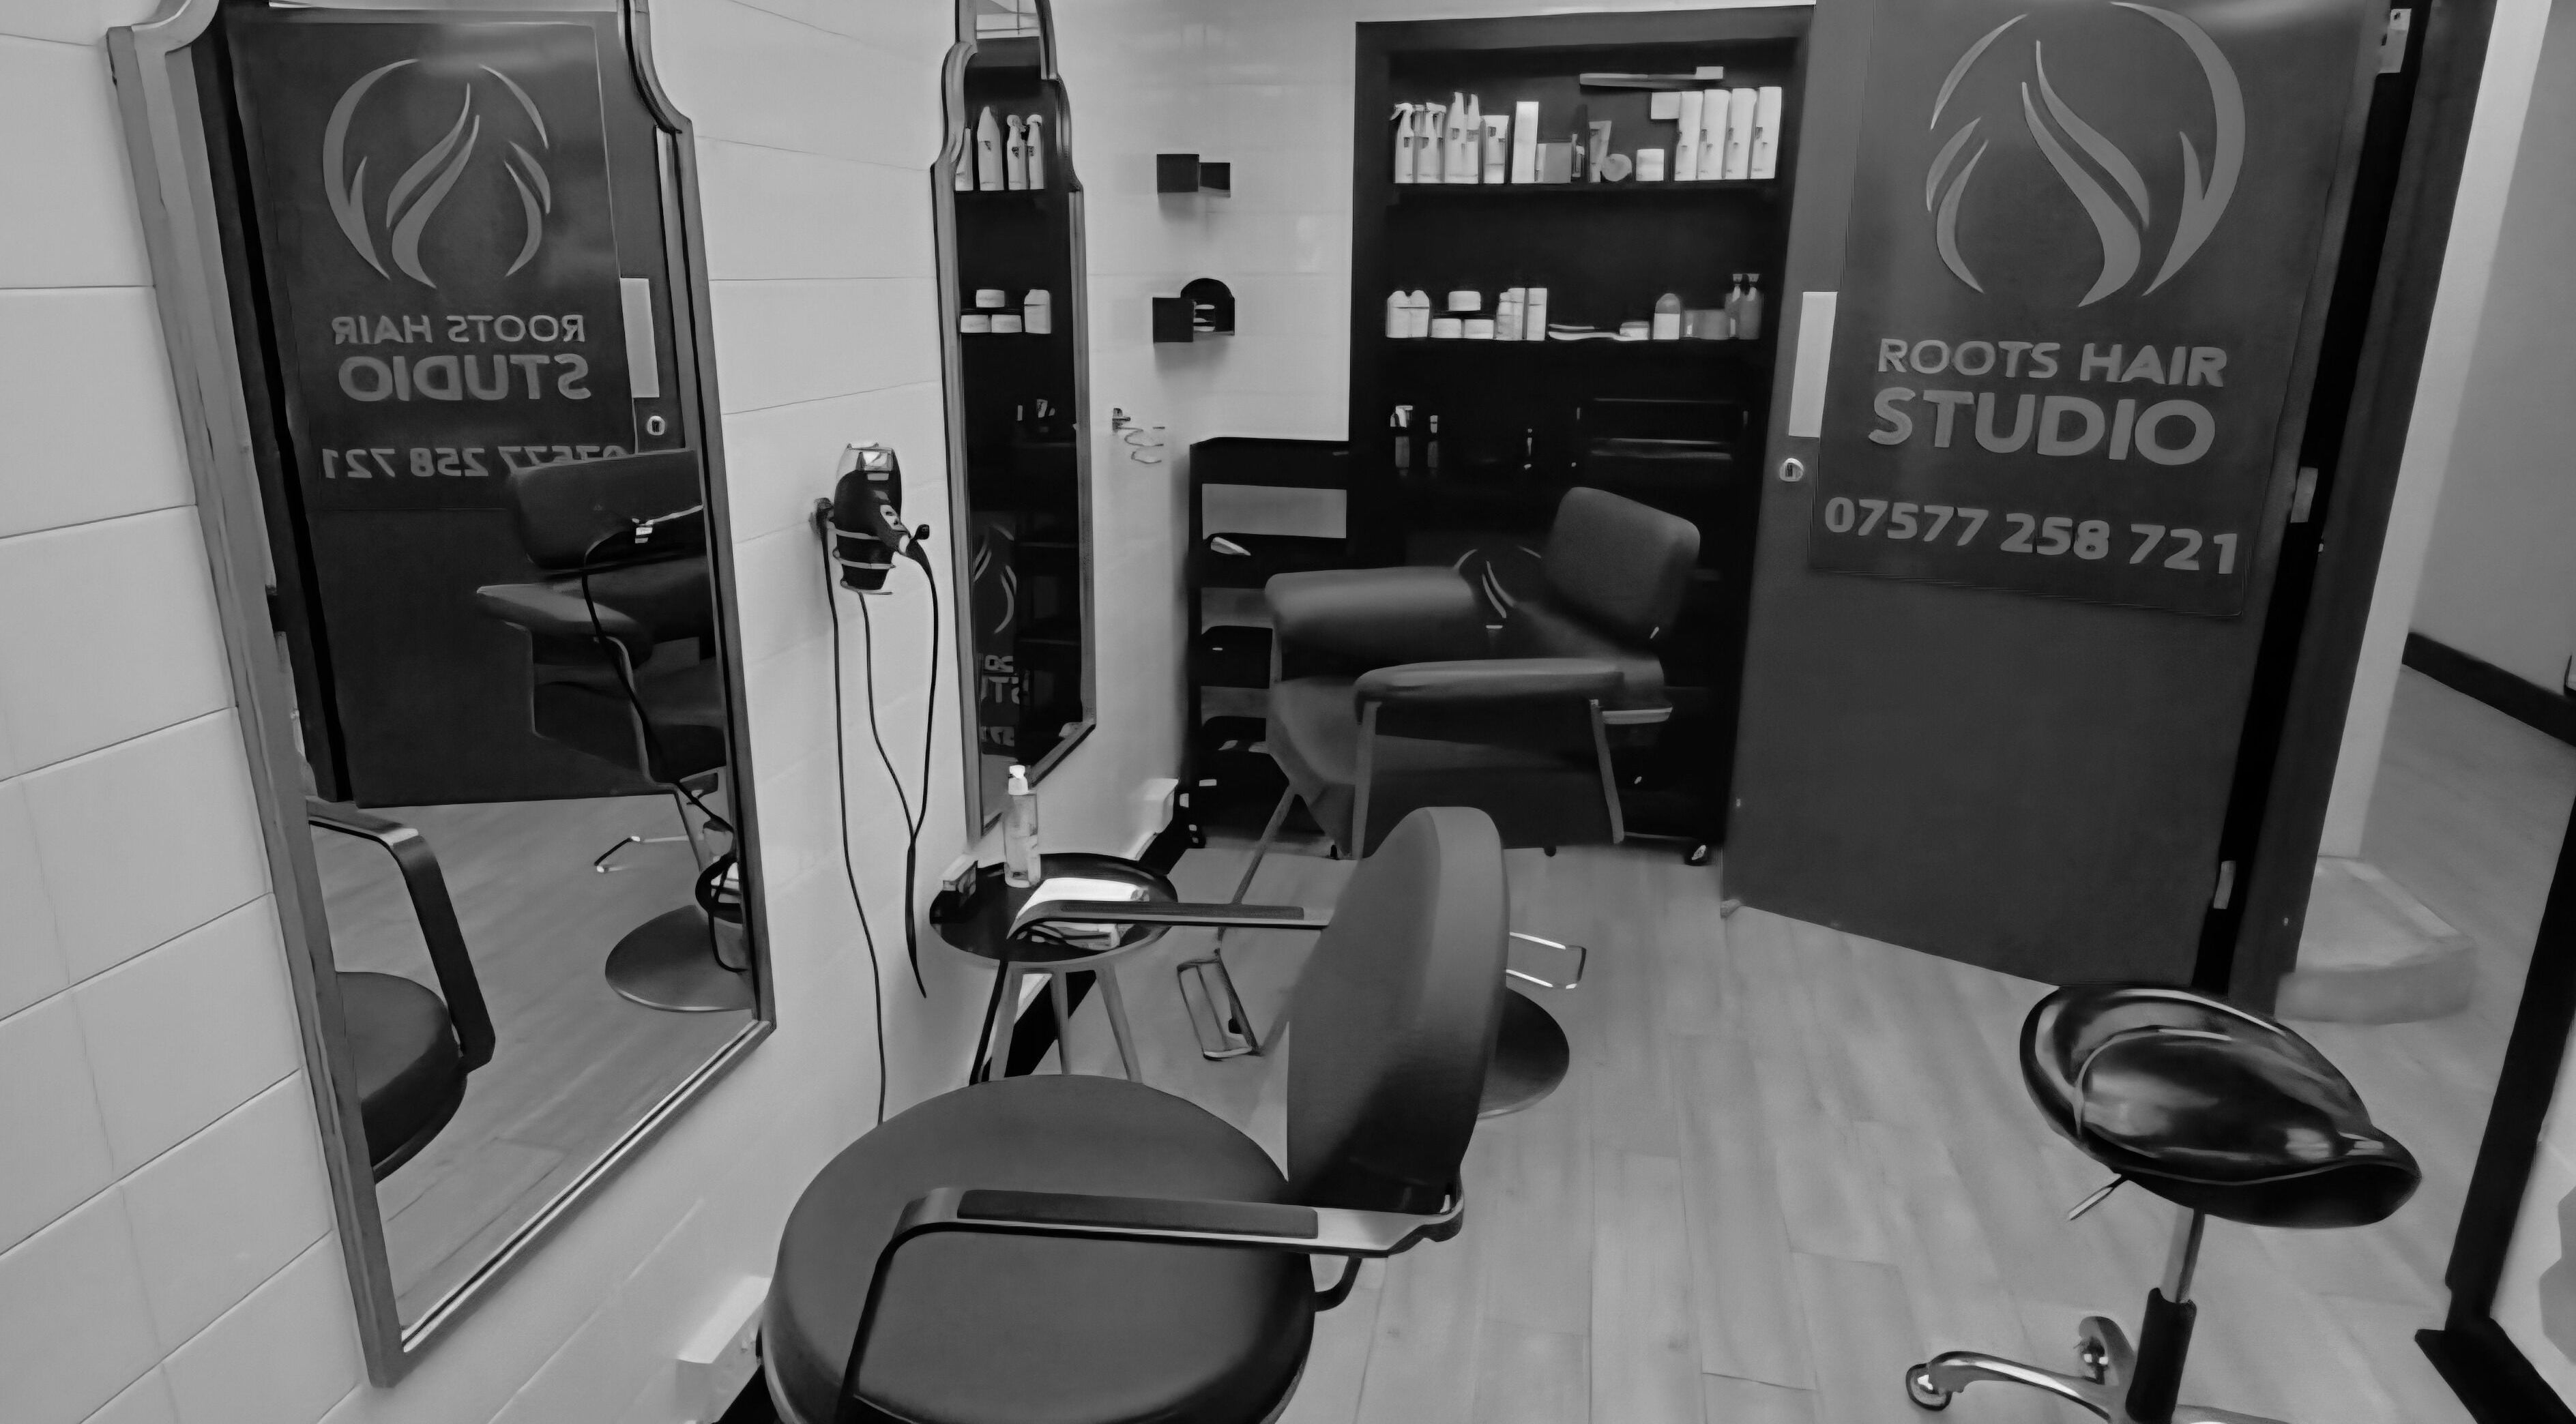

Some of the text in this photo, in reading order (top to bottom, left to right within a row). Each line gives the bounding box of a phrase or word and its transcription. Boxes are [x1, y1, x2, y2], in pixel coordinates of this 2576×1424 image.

[1877, 338, 2227, 387] ROOTS HAIR
[1868, 387, 2216, 466] STUDIO
[1824, 497, 2238, 574] 07577 258 721
